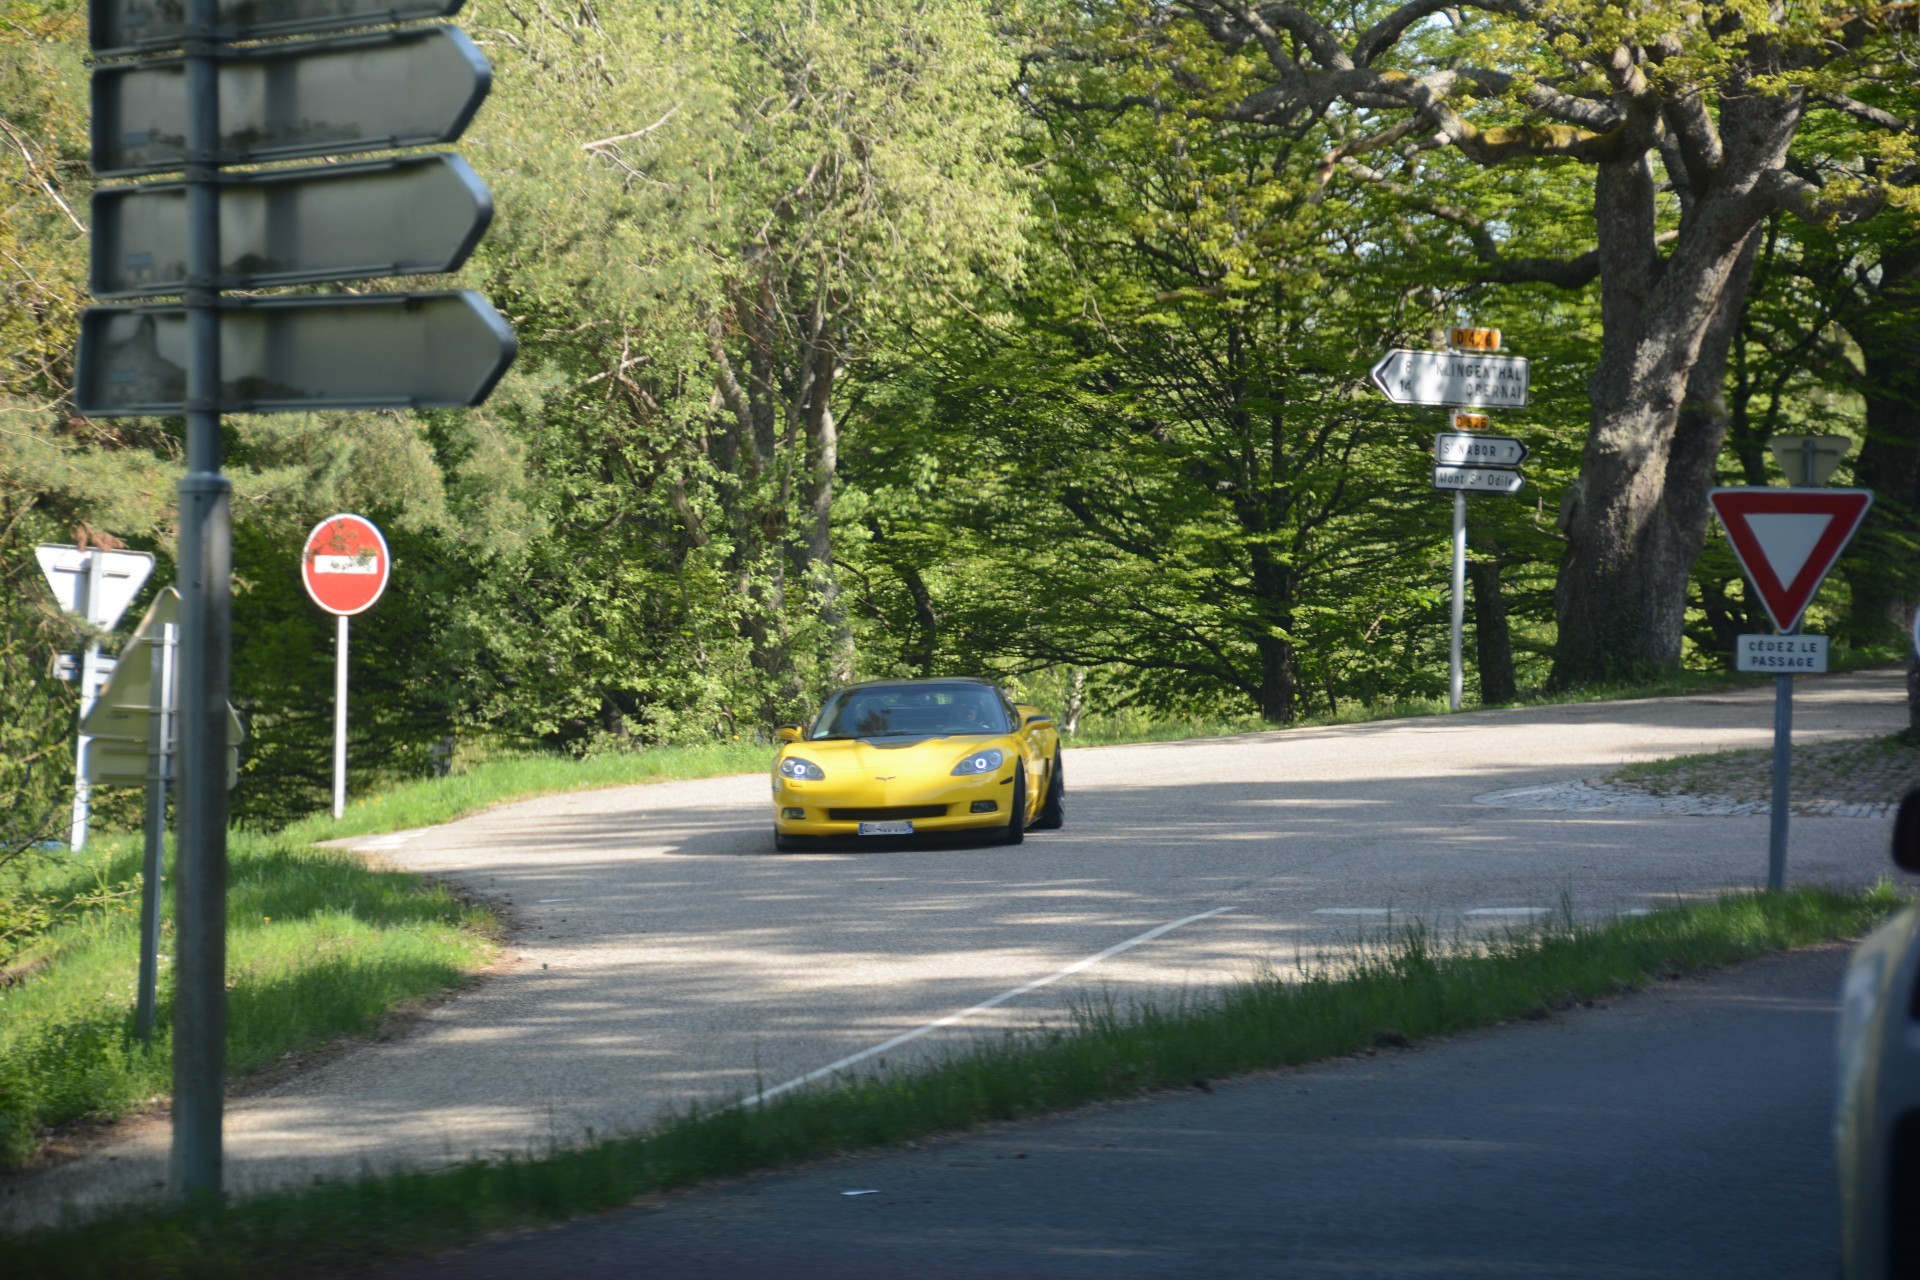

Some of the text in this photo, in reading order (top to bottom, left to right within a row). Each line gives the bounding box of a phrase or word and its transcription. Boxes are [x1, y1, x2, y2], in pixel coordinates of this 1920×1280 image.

[1456, 330, 1464, 345] D
[1436, 362, 1522, 381] KLINGENTHAL
[1465, 383, 1522, 399] OBERNAI
[1458, 444, 1497, 457] NABOR
[1507, 446, 1515, 458] 7
[1439, 472, 1464, 485] Mont
[1487, 474, 1514, 487] Odile
[1748, 640, 1818, 653] CÉDEZ LE
[1751, 655, 1815, 668] PASSAGE
